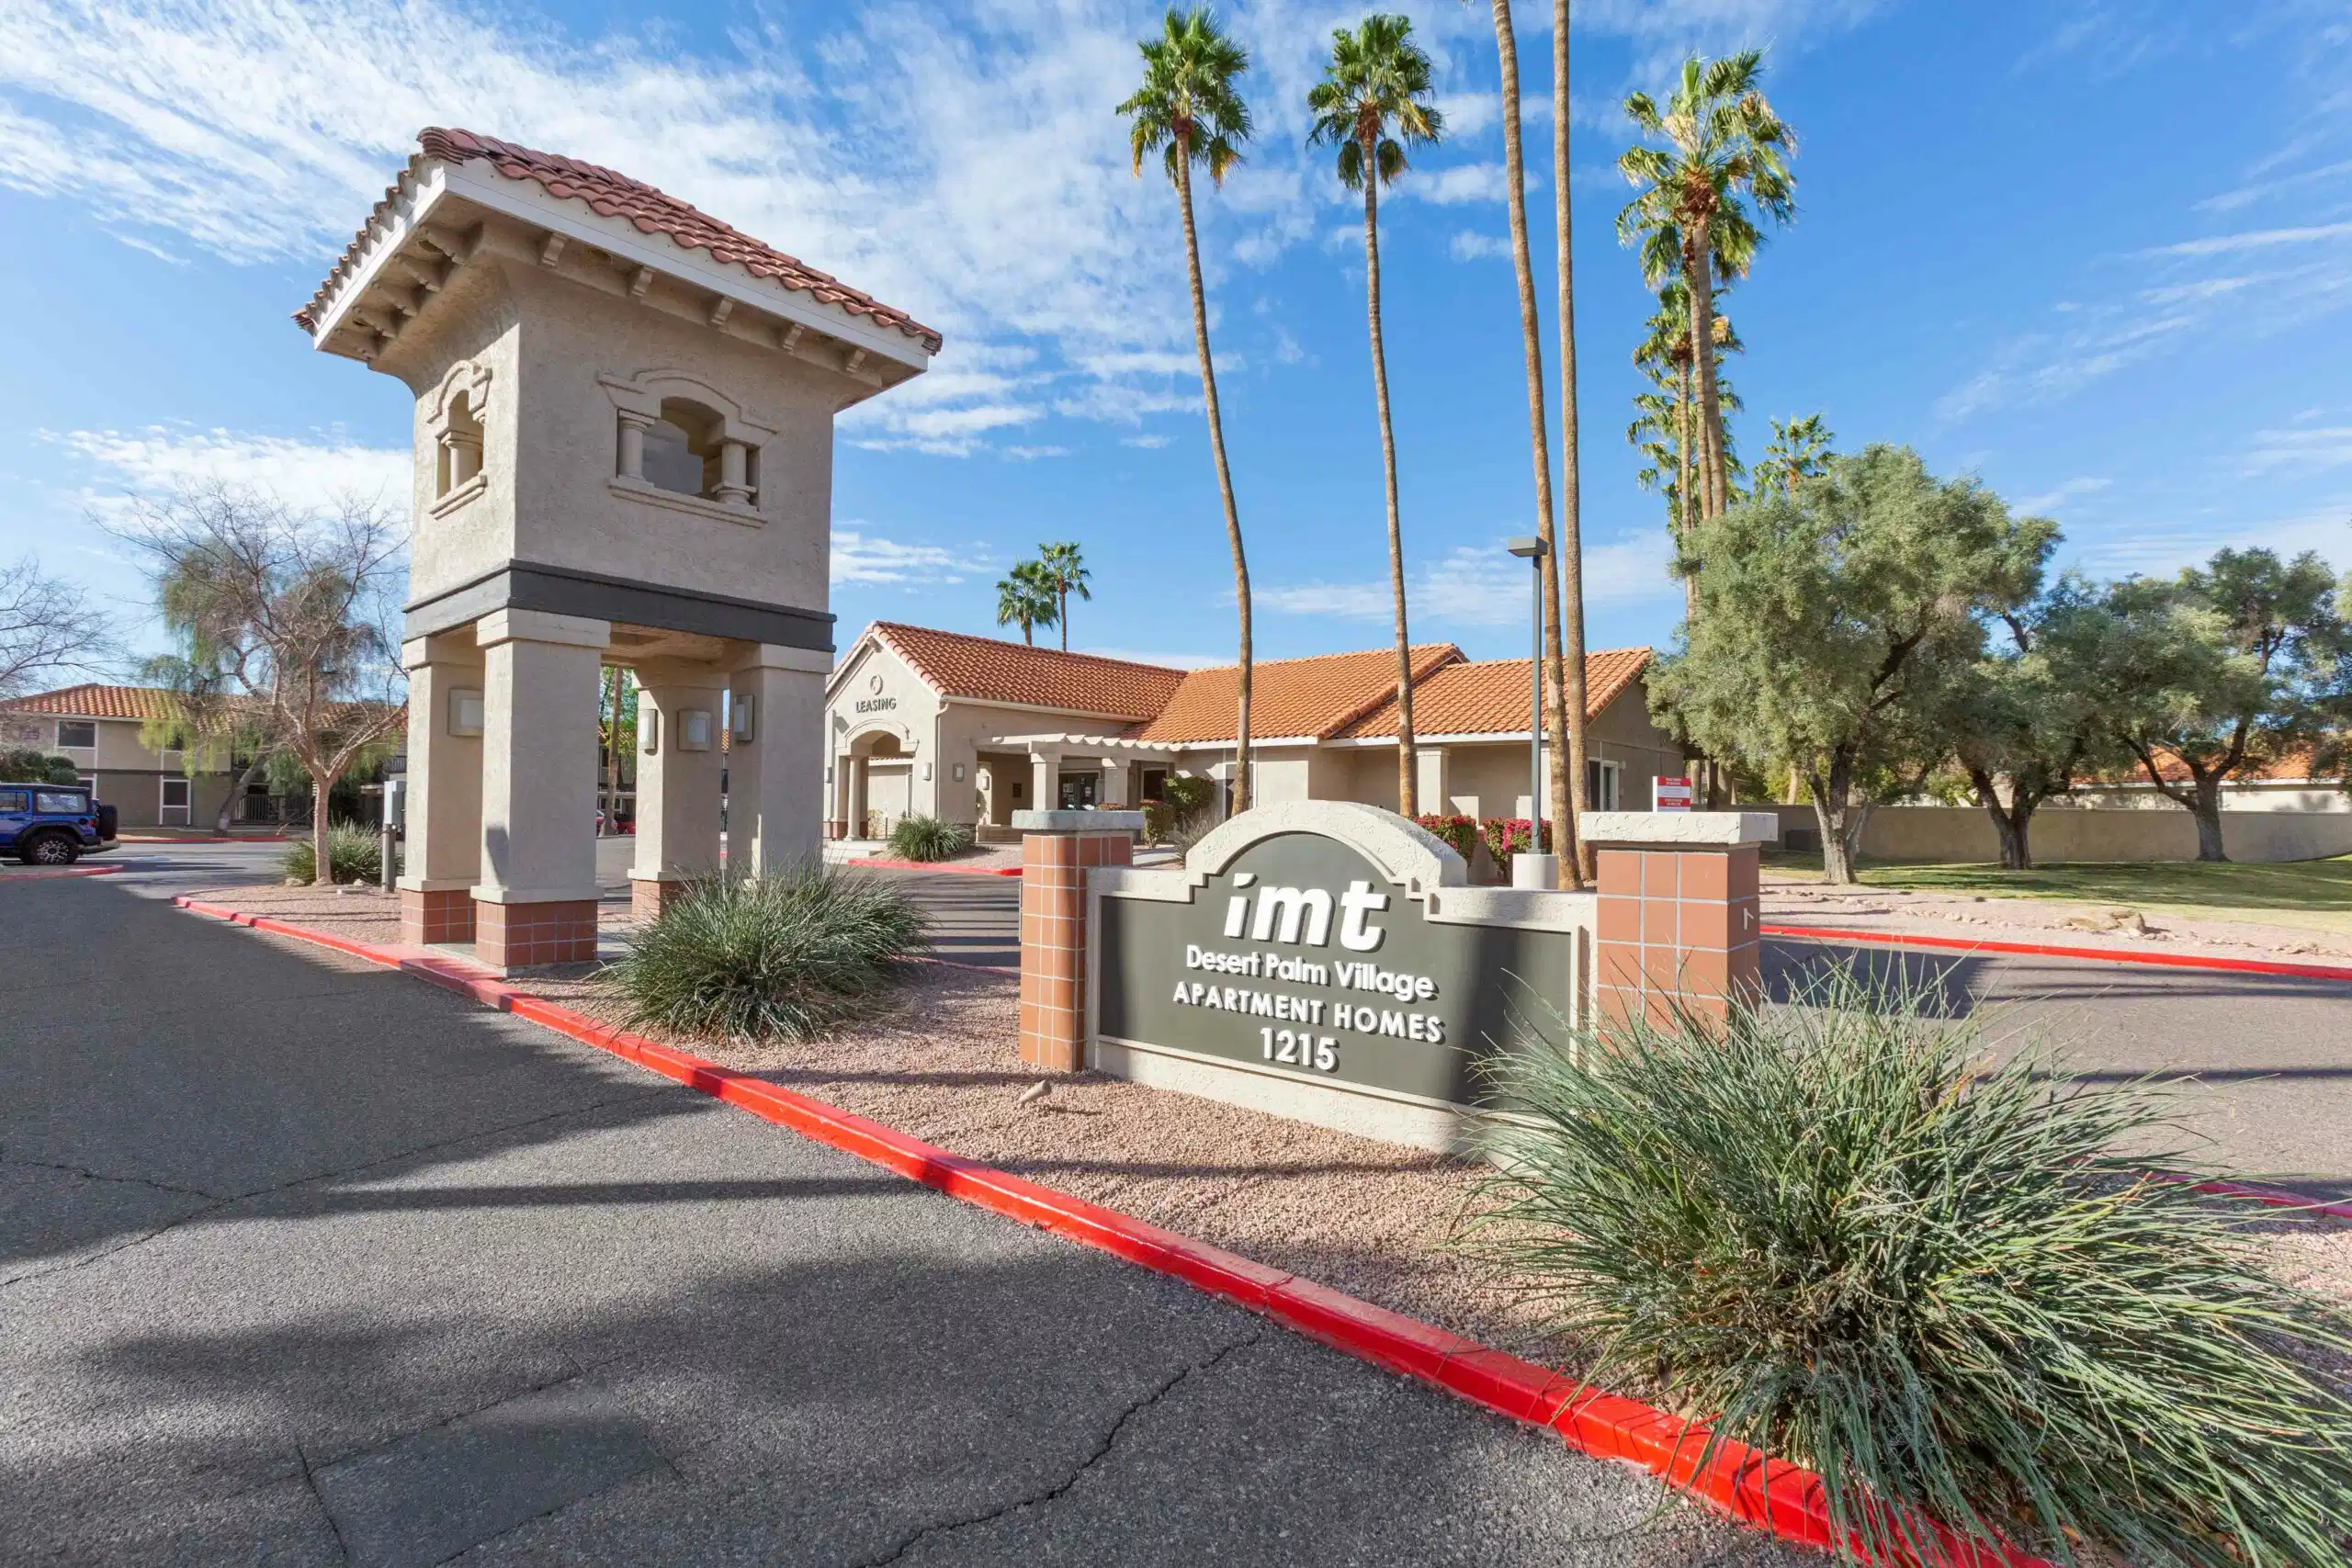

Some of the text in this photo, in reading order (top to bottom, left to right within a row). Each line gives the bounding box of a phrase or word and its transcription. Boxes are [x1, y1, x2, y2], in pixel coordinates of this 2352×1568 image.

[855, 697, 897, 714] LEASING
[1224, 873, 1389, 952] imt
[1186, 944, 1437, 1001] Desert Palm Village
[1172, 981, 1444, 1043] APARTMENT HOMES
[1260, 1027, 1339, 1071] 1215
